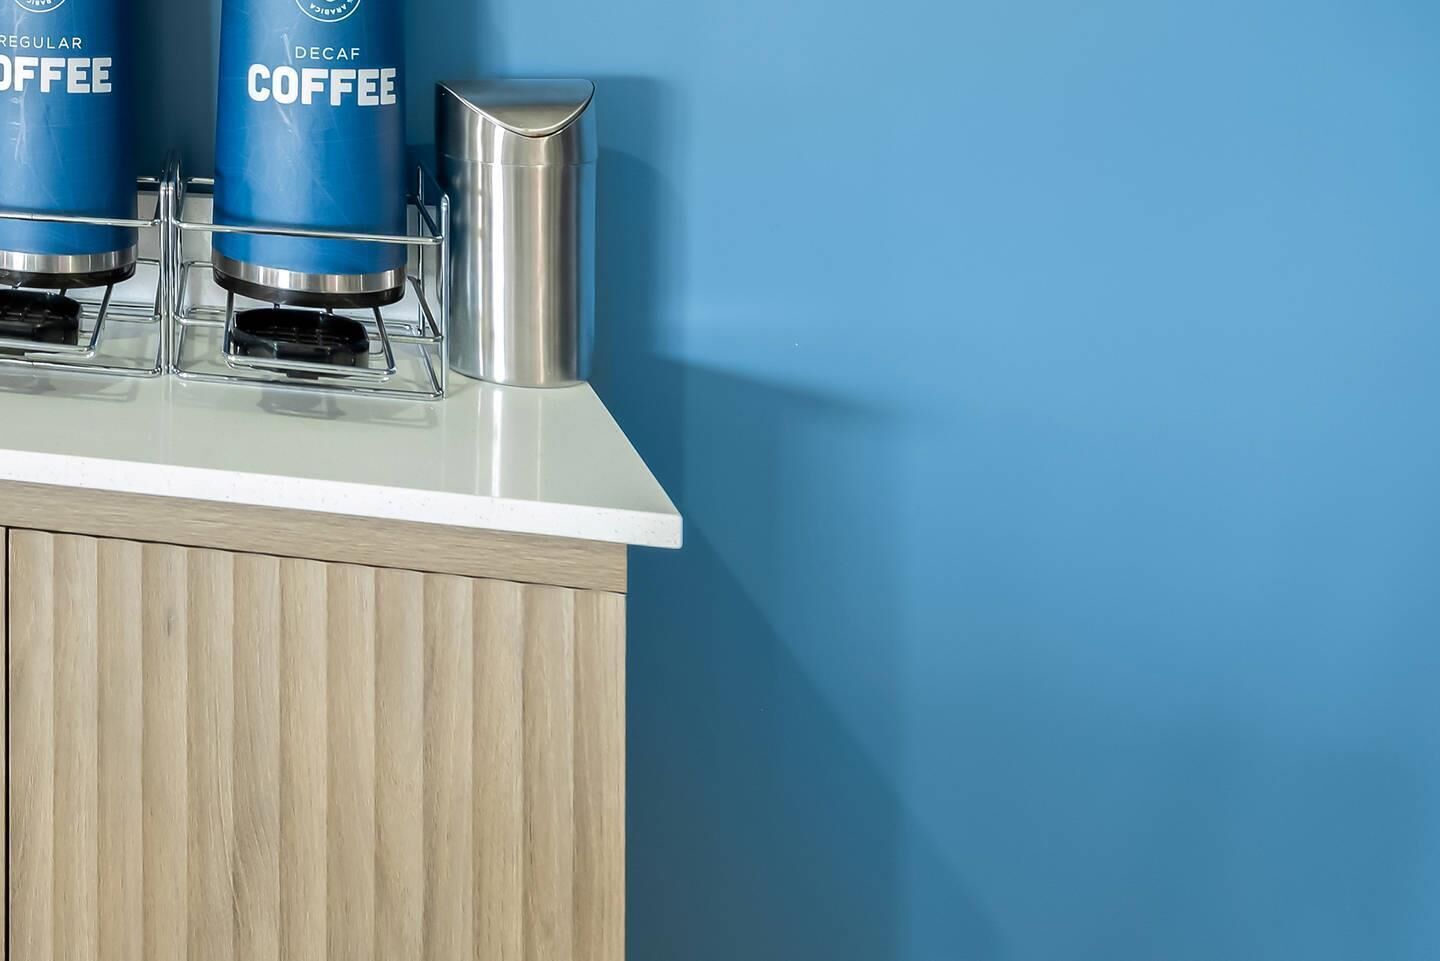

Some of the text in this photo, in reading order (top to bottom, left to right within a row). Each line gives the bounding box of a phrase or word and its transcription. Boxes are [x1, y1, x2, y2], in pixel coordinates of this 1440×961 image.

[309, 3, 347, 16] ARABICA
[295, 46, 360, 60] DECAF
[247, 63, 397, 106] COFFEE
